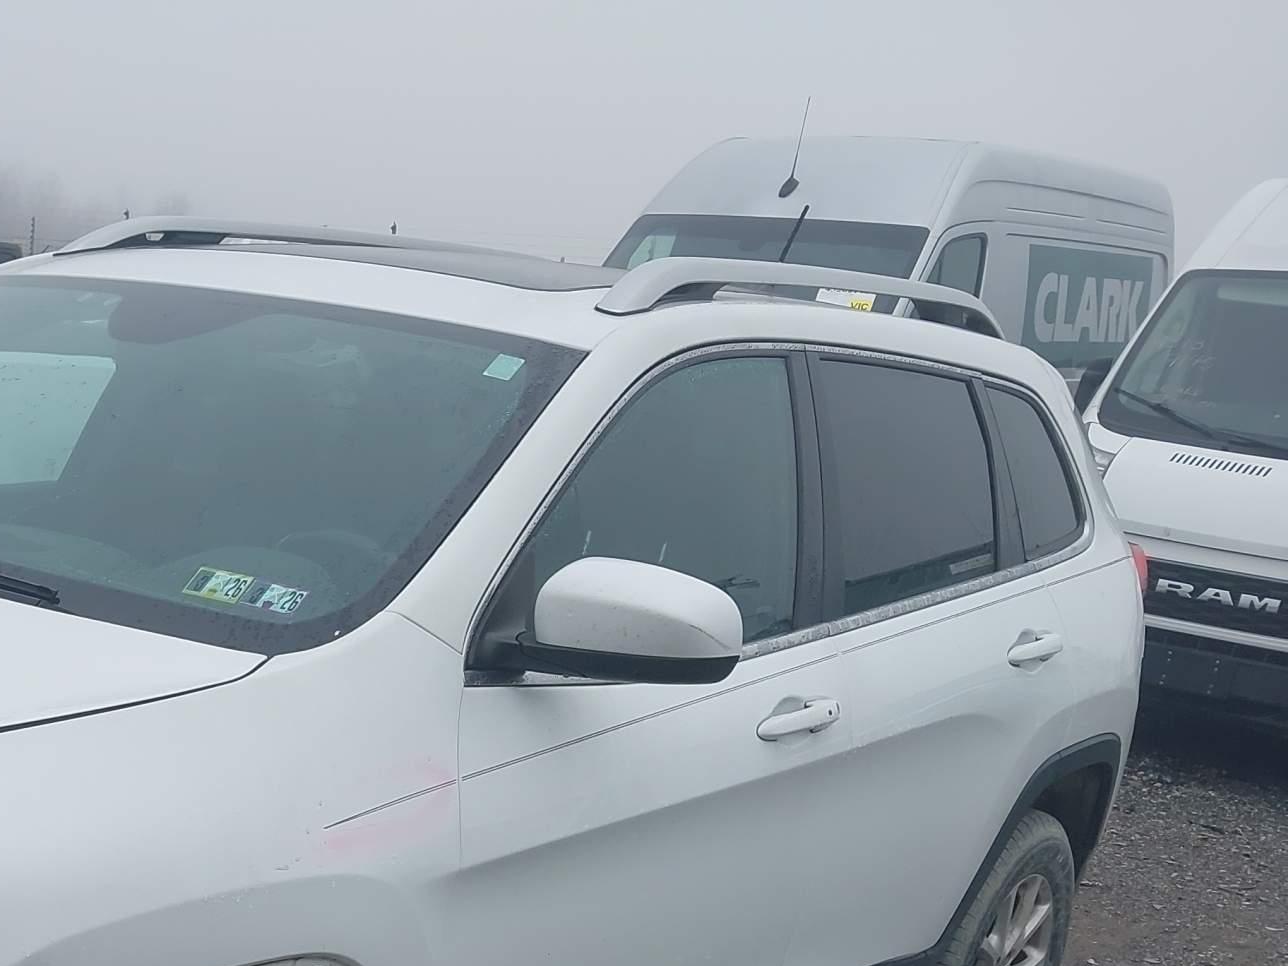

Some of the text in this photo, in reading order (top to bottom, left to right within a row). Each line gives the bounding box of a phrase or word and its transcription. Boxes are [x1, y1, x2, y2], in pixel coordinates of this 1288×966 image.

[1034, 272, 1145, 343] CLARK
[223, 577, 248, 599] 26
[279, 590, 304, 612] 26
[1155, 578, 1282, 614] RAM
